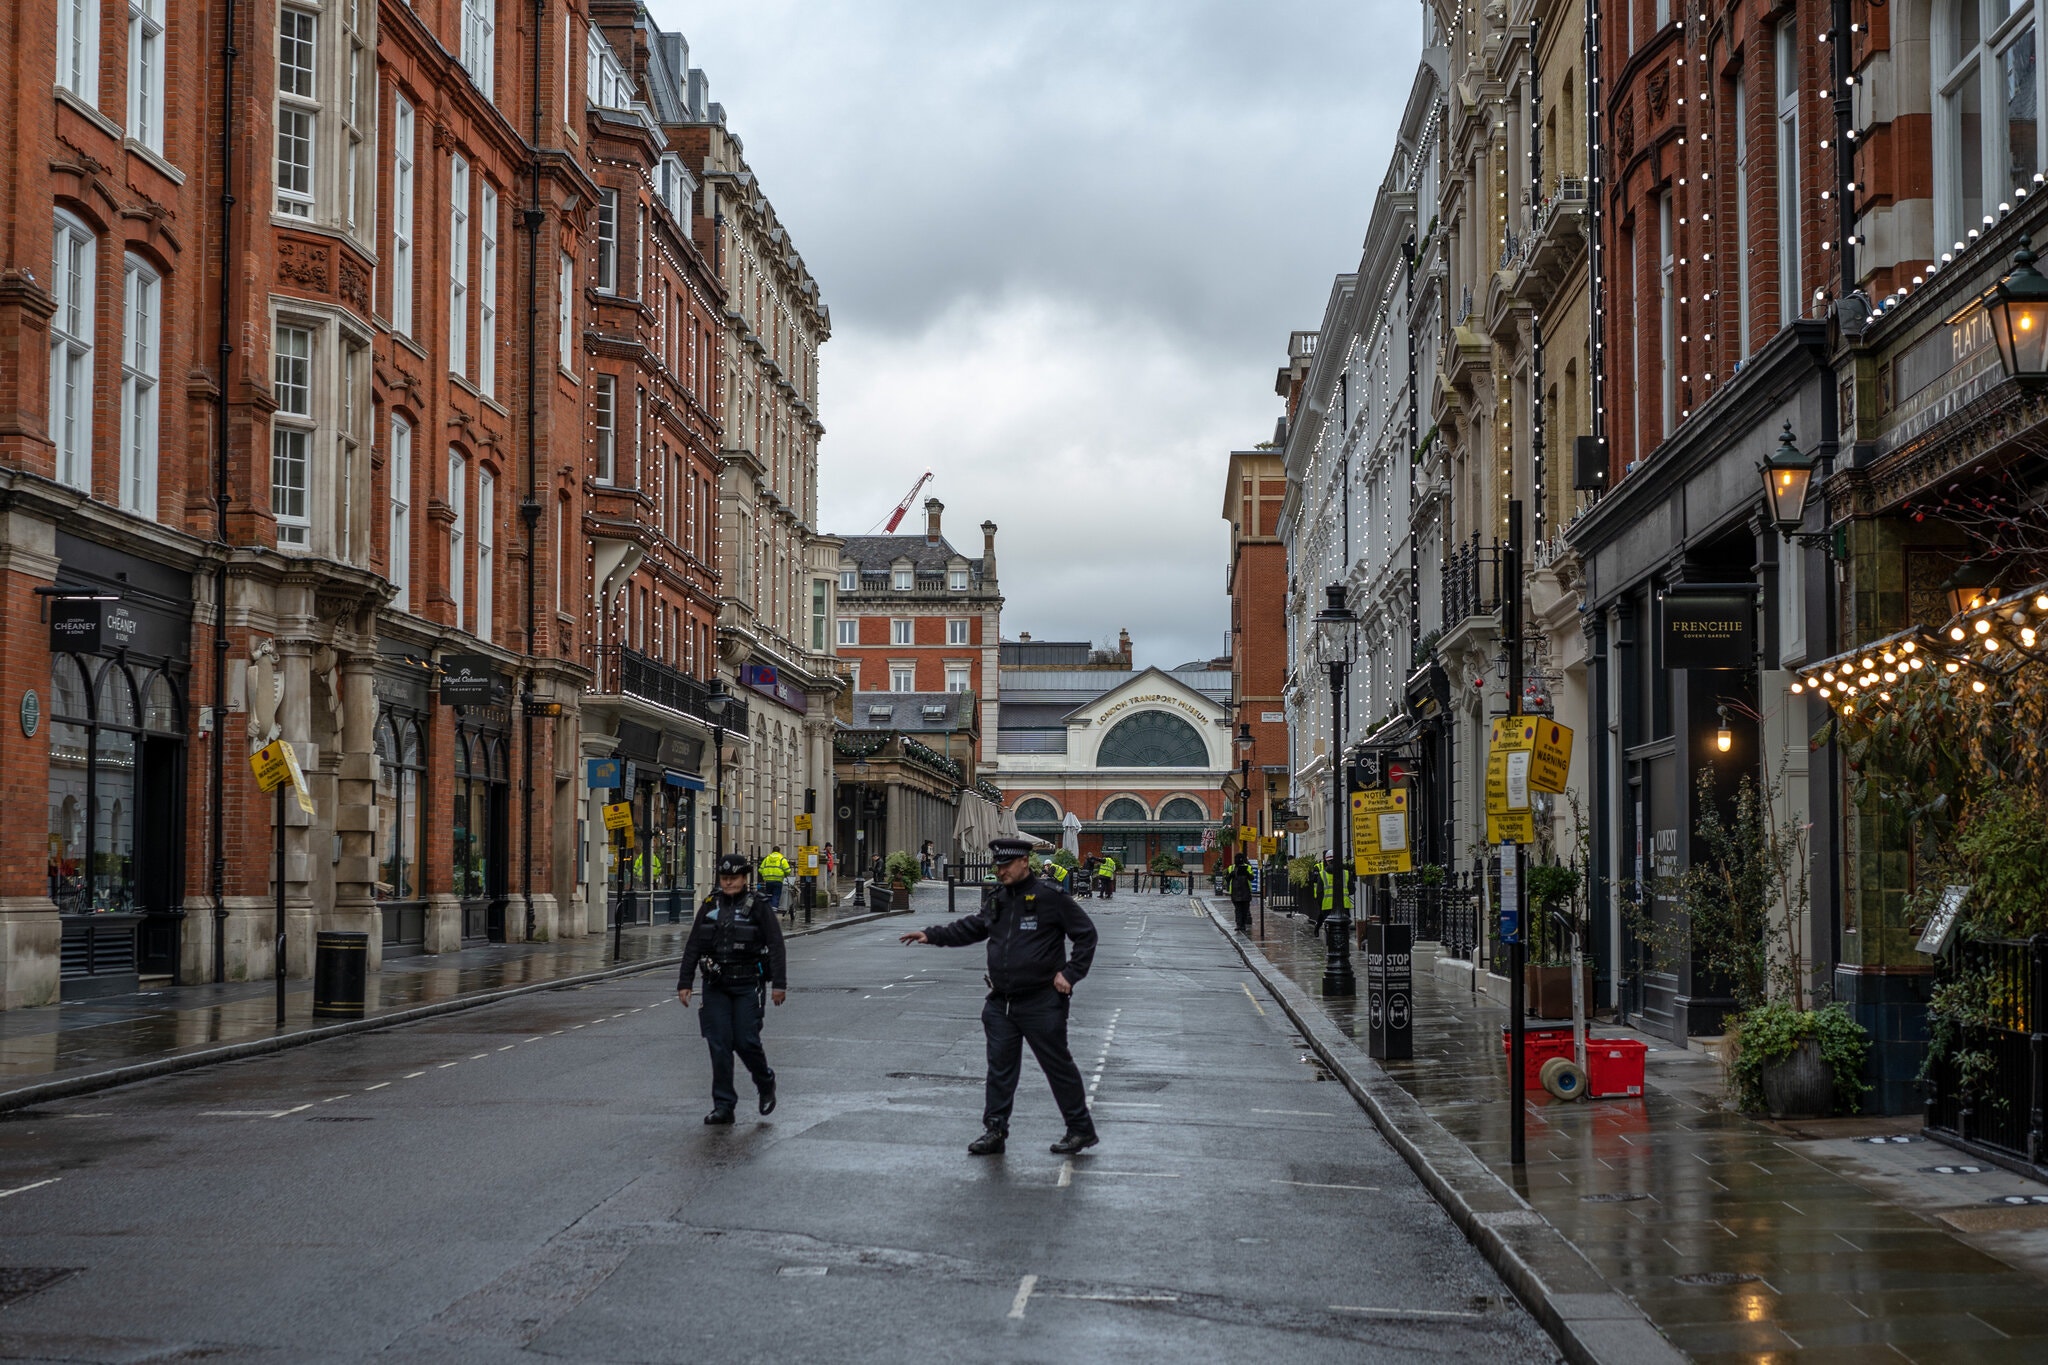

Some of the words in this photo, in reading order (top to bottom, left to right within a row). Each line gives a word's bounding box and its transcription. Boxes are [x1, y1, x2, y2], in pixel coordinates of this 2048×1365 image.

[1953, 316, 1978, 363] FLAT
[1981, 309, 1993, 343] IR
[54, 622, 96, 630] CHEANEY
[107, 615, 137, 634] CHEANEY
[1672, 621, 1743, 631] FRENCHIE
[1097, 700, 1128, 726] LONDON
[1128, 694, 1177, 705] TRANSPORT
[1178, 700, 1209, 726] MUSEUM
[1501, 718, 1523, 728] NOTICE
[1502, 731, 1519, 739] Parking
[1498, 741, 1522, 749] Suspended
[1537, 750, 1567, 770] WARNING
[258, 759, 284, 779] WARNING
[1543, 765, 1557, 778] Parking
[1364, 791, 1387, 800] NOTIC
[1506, 822, 1523, 831] waiting
[1369, 954, 1382, 965] STOP
[1387, 954, 1409, 965] STOP
